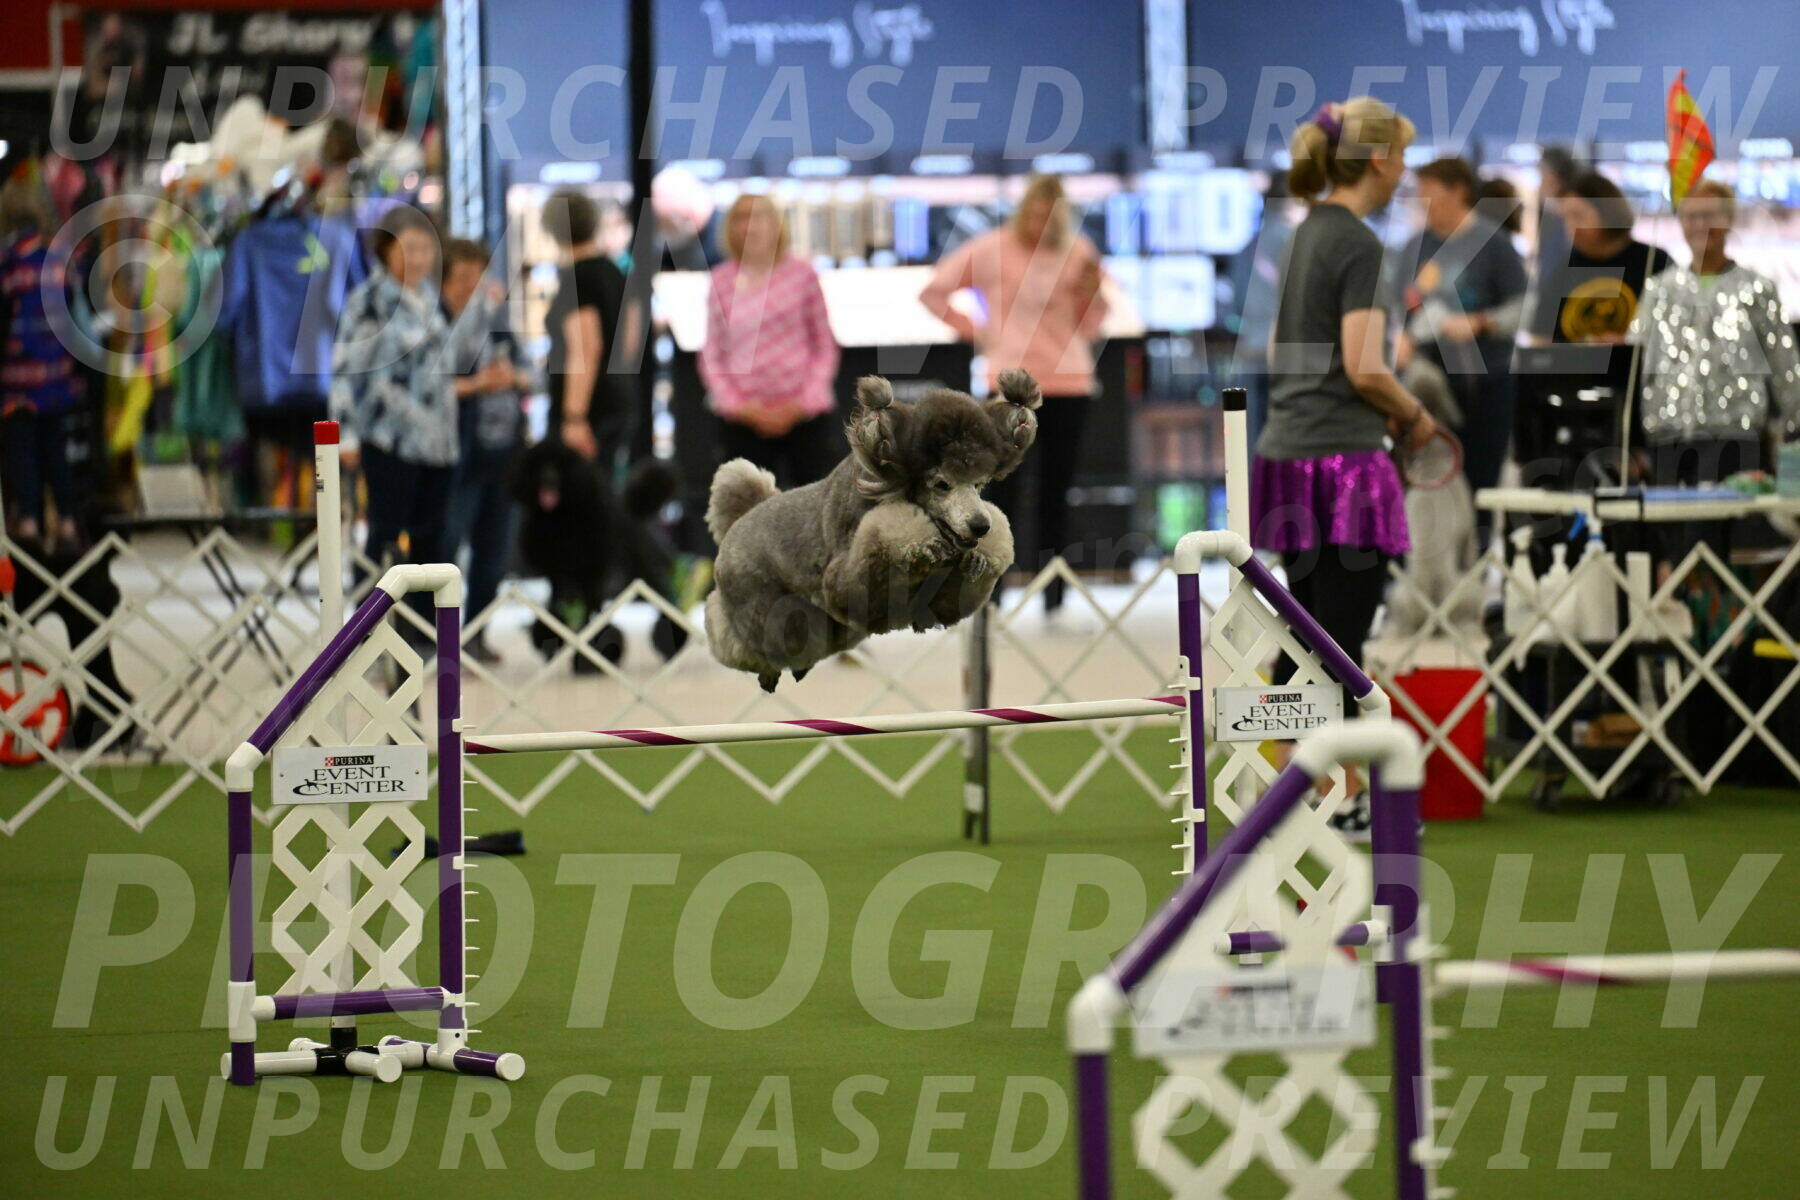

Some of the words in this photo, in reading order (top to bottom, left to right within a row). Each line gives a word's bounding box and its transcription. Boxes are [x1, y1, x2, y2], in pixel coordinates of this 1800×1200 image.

[1268, 693, 1301, 703] PURINA
[1250, 703, 1315, 717] EVENT
[1231, 716, 1328, 731] CENTER
[335, 756, 373, 766] PURINA
[313, 766, 391, 781] EVENT
[292, 779, 406, 795] CENTER
